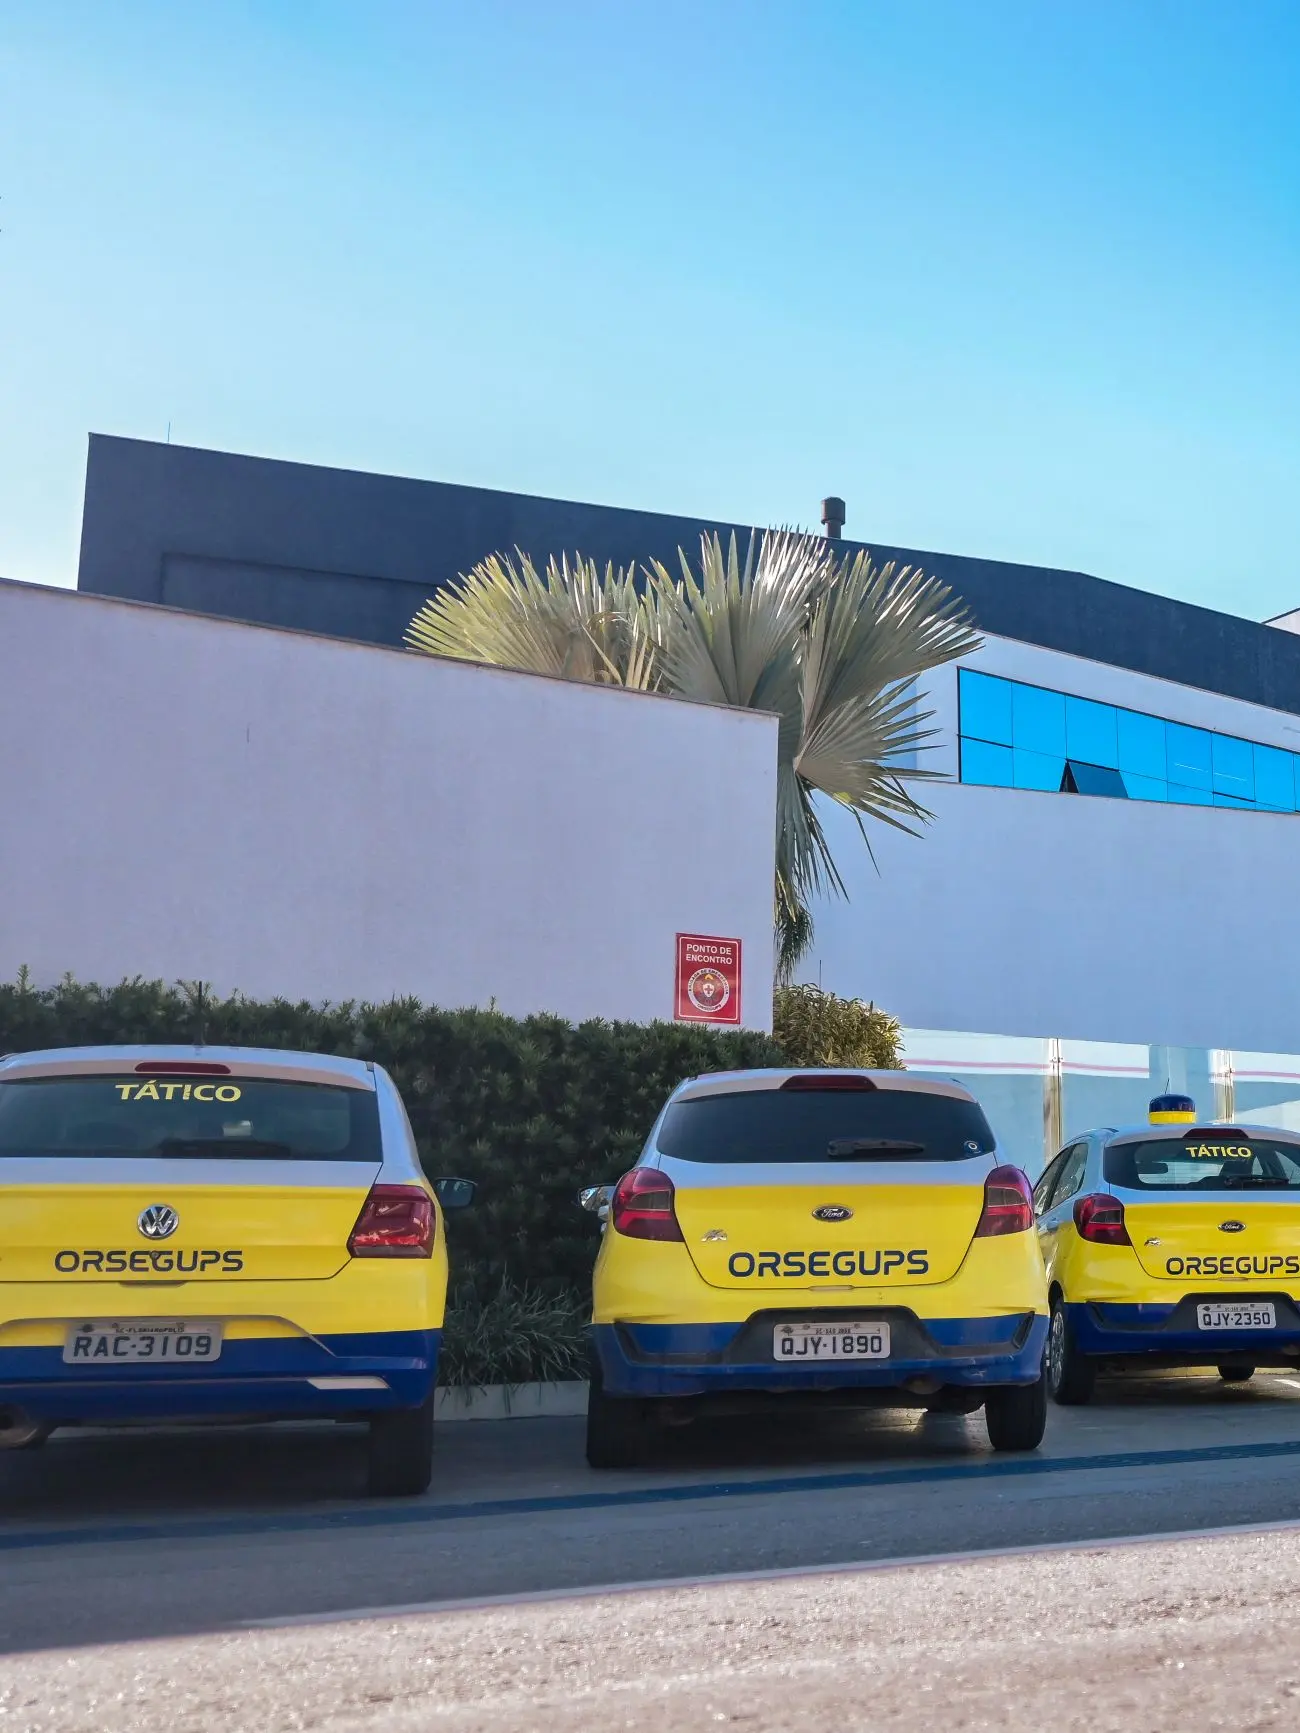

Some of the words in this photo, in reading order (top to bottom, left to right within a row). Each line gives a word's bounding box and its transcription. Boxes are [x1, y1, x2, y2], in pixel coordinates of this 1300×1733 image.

[686, 943, 718, 954] PONTO
[719, 946, 732, 955] DE
[685, 953, 733, 965] ENCONTRO
[115, 1080, 242, 1102] TÁTICO
[1185, 1144, 1252, 1158] TÁTICO
[54, 1250, 244, 1273] ORSEGUPS
[728, 1250, 929, 1277] ORSEGUPS
[1166, 1256, 1300, 1275] ORSEGUPS
